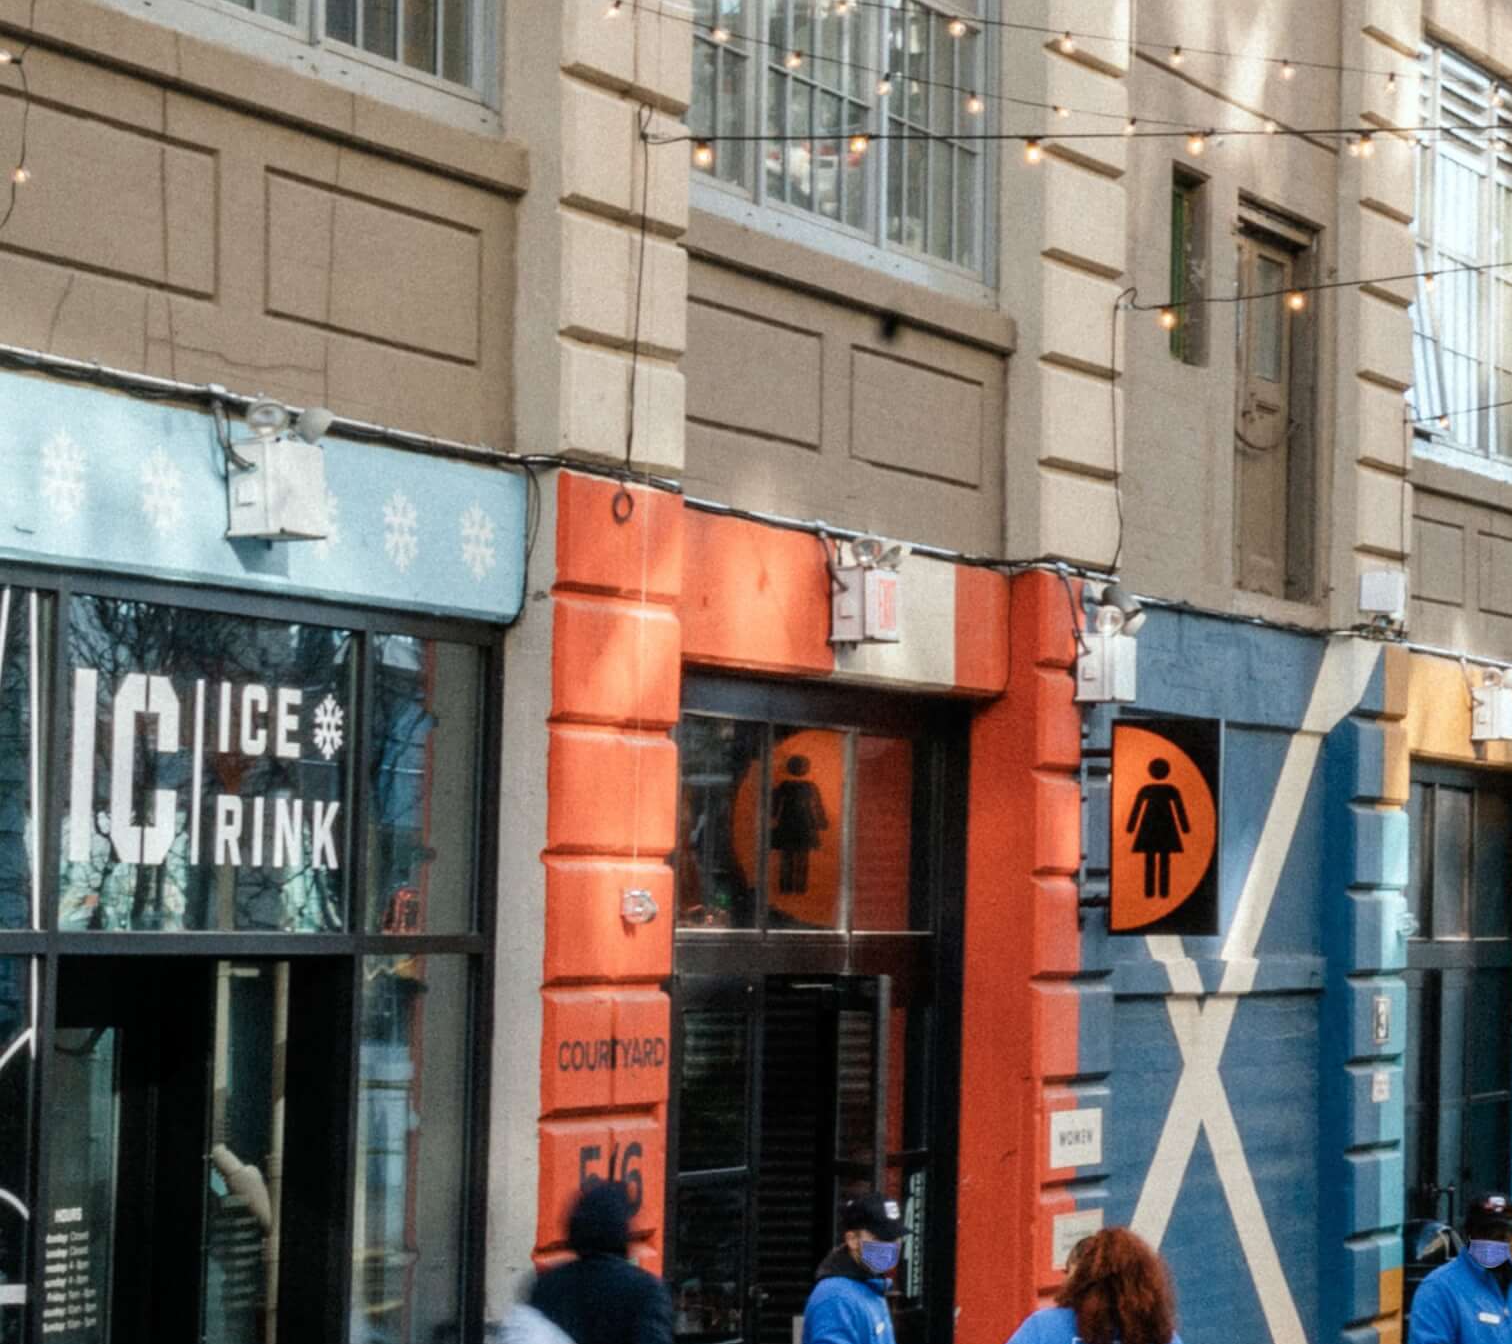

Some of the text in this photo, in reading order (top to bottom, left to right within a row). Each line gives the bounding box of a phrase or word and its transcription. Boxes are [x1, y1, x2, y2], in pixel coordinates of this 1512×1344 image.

[218, 681, 302, 758] ICE
[68, 667, 180, 865] IC
[214, 793, 340, 869] RINK
[558, 1037, 665, 1072] COURTYARD
[1059, 1129, 1094, 1147] WOMEN
